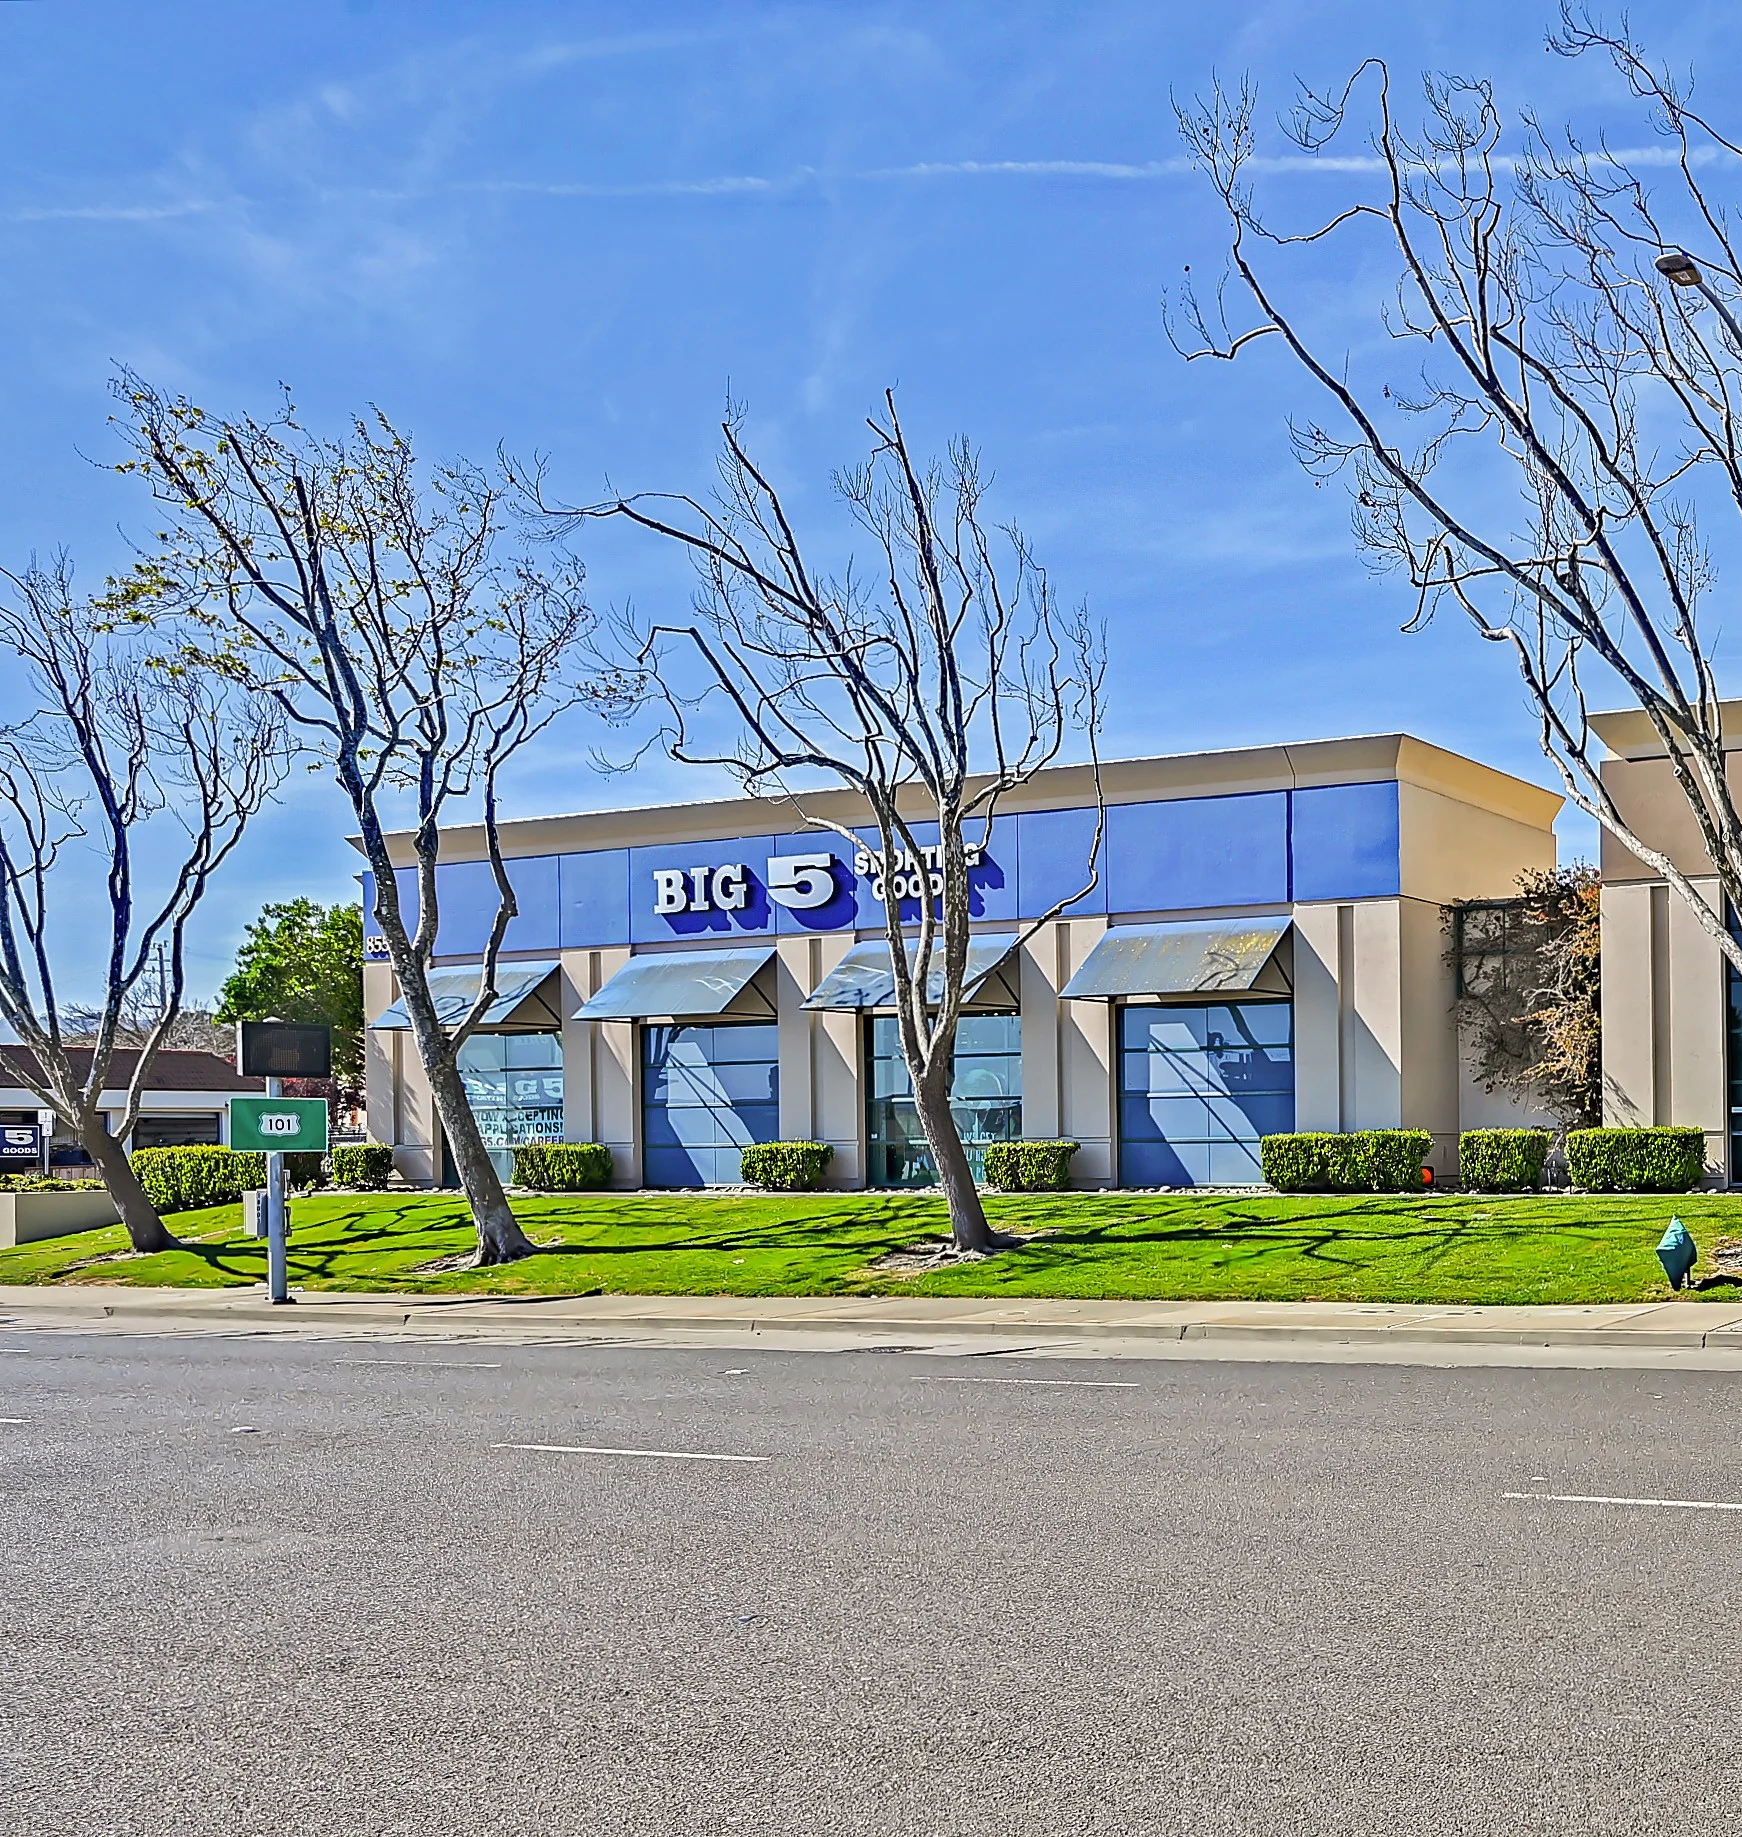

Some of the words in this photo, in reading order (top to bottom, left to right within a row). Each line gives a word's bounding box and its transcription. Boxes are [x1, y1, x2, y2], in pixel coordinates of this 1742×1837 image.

[854, 842, 980, 876] SPORTIG
[653, 864, 747, 914] BIG
[766, 852, 834, 909] 5
[872, 873, 945, 901] GOOD
[5, 1130, 34, 1145] 5
[268, 1118, 292, 1132] 101
